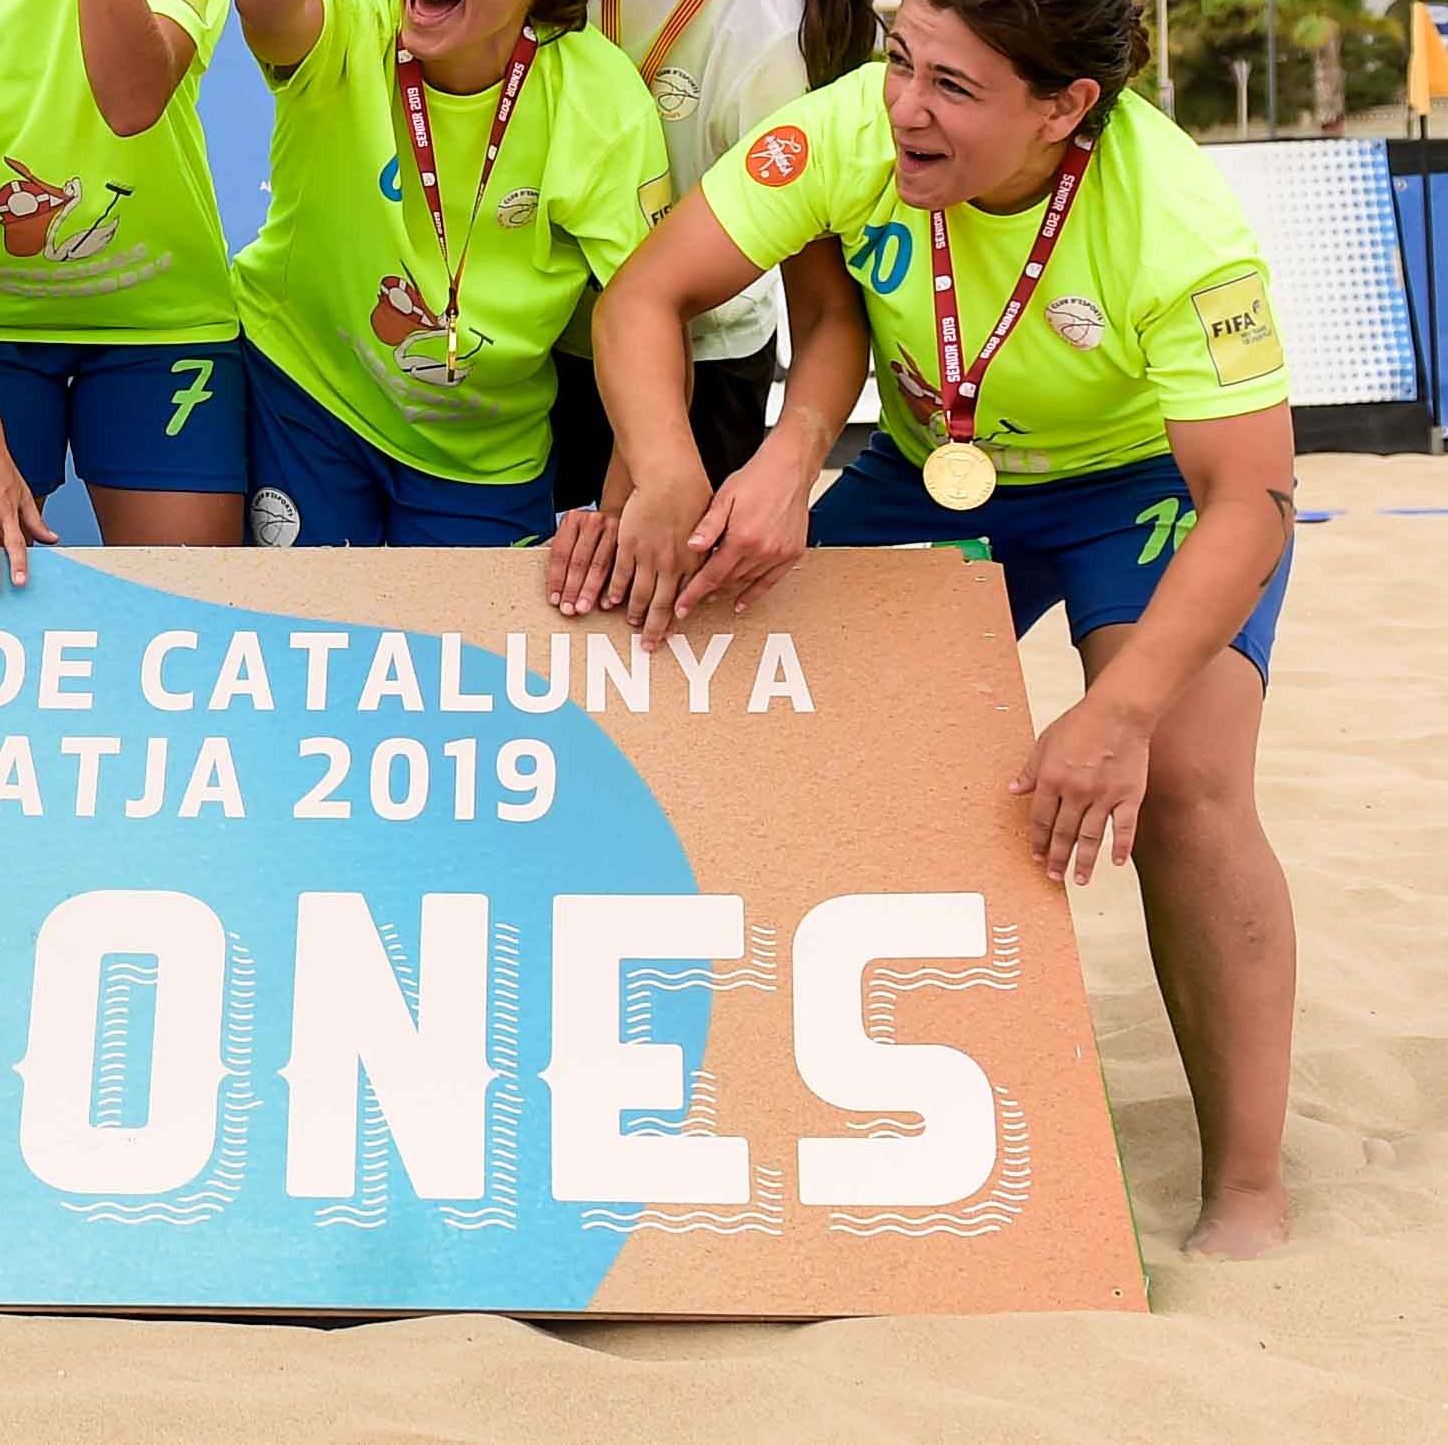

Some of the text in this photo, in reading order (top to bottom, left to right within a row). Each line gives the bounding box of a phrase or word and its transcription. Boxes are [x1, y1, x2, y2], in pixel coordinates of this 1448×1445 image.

[498, 62, 526, 123] SENIOR 2019
[411, 109, 429, 149] SENIOR
[933, 211, 947, 250] SENIOR
[1042, 172, 1077, 239] SENIOR 2019
[848, 221, 913, 295] 10
[941, 316, 962, 384] SENIOR 2019
[979, 300, 1022, 360] SENIOR 2019
[1211, 312, 1256, 339] FIFA
[165, 359, 214, 437] 7
[140, 629, 816, 715] CATALUNYA
[293, 736, 559, 822] 2019
